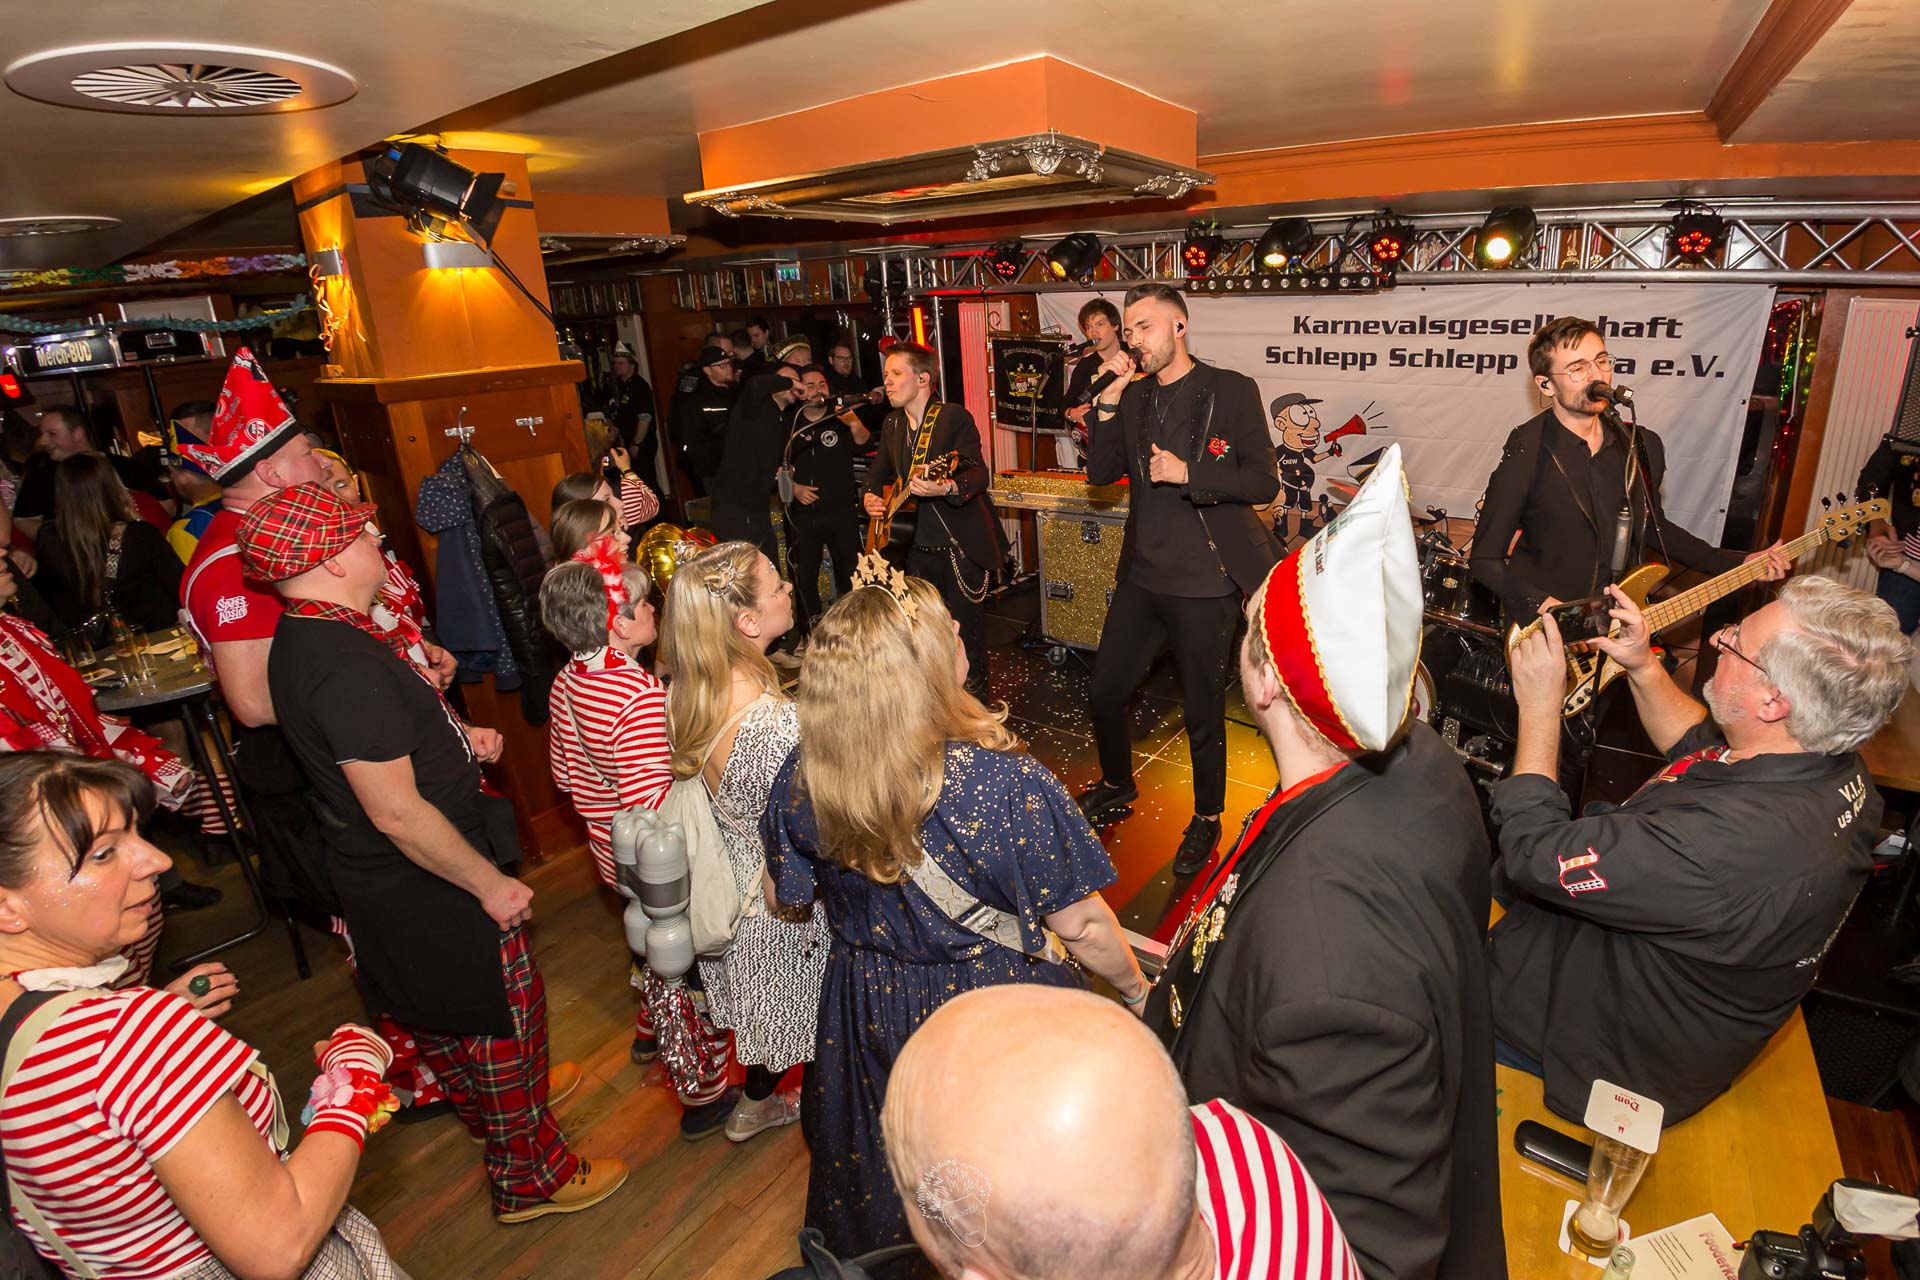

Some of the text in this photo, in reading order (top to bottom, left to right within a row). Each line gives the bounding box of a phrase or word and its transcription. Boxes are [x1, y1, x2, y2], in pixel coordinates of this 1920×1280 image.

[1293, 314, 1684, 340] Karnevalsgeselhaft
[1265, 346, 1378, 371] Schlepp
[1388, 347, 1519, 375] Schlepp
[1650, 354, 1725, 378] e.V.
[1614, 1094, 1640, 1113] Dom
